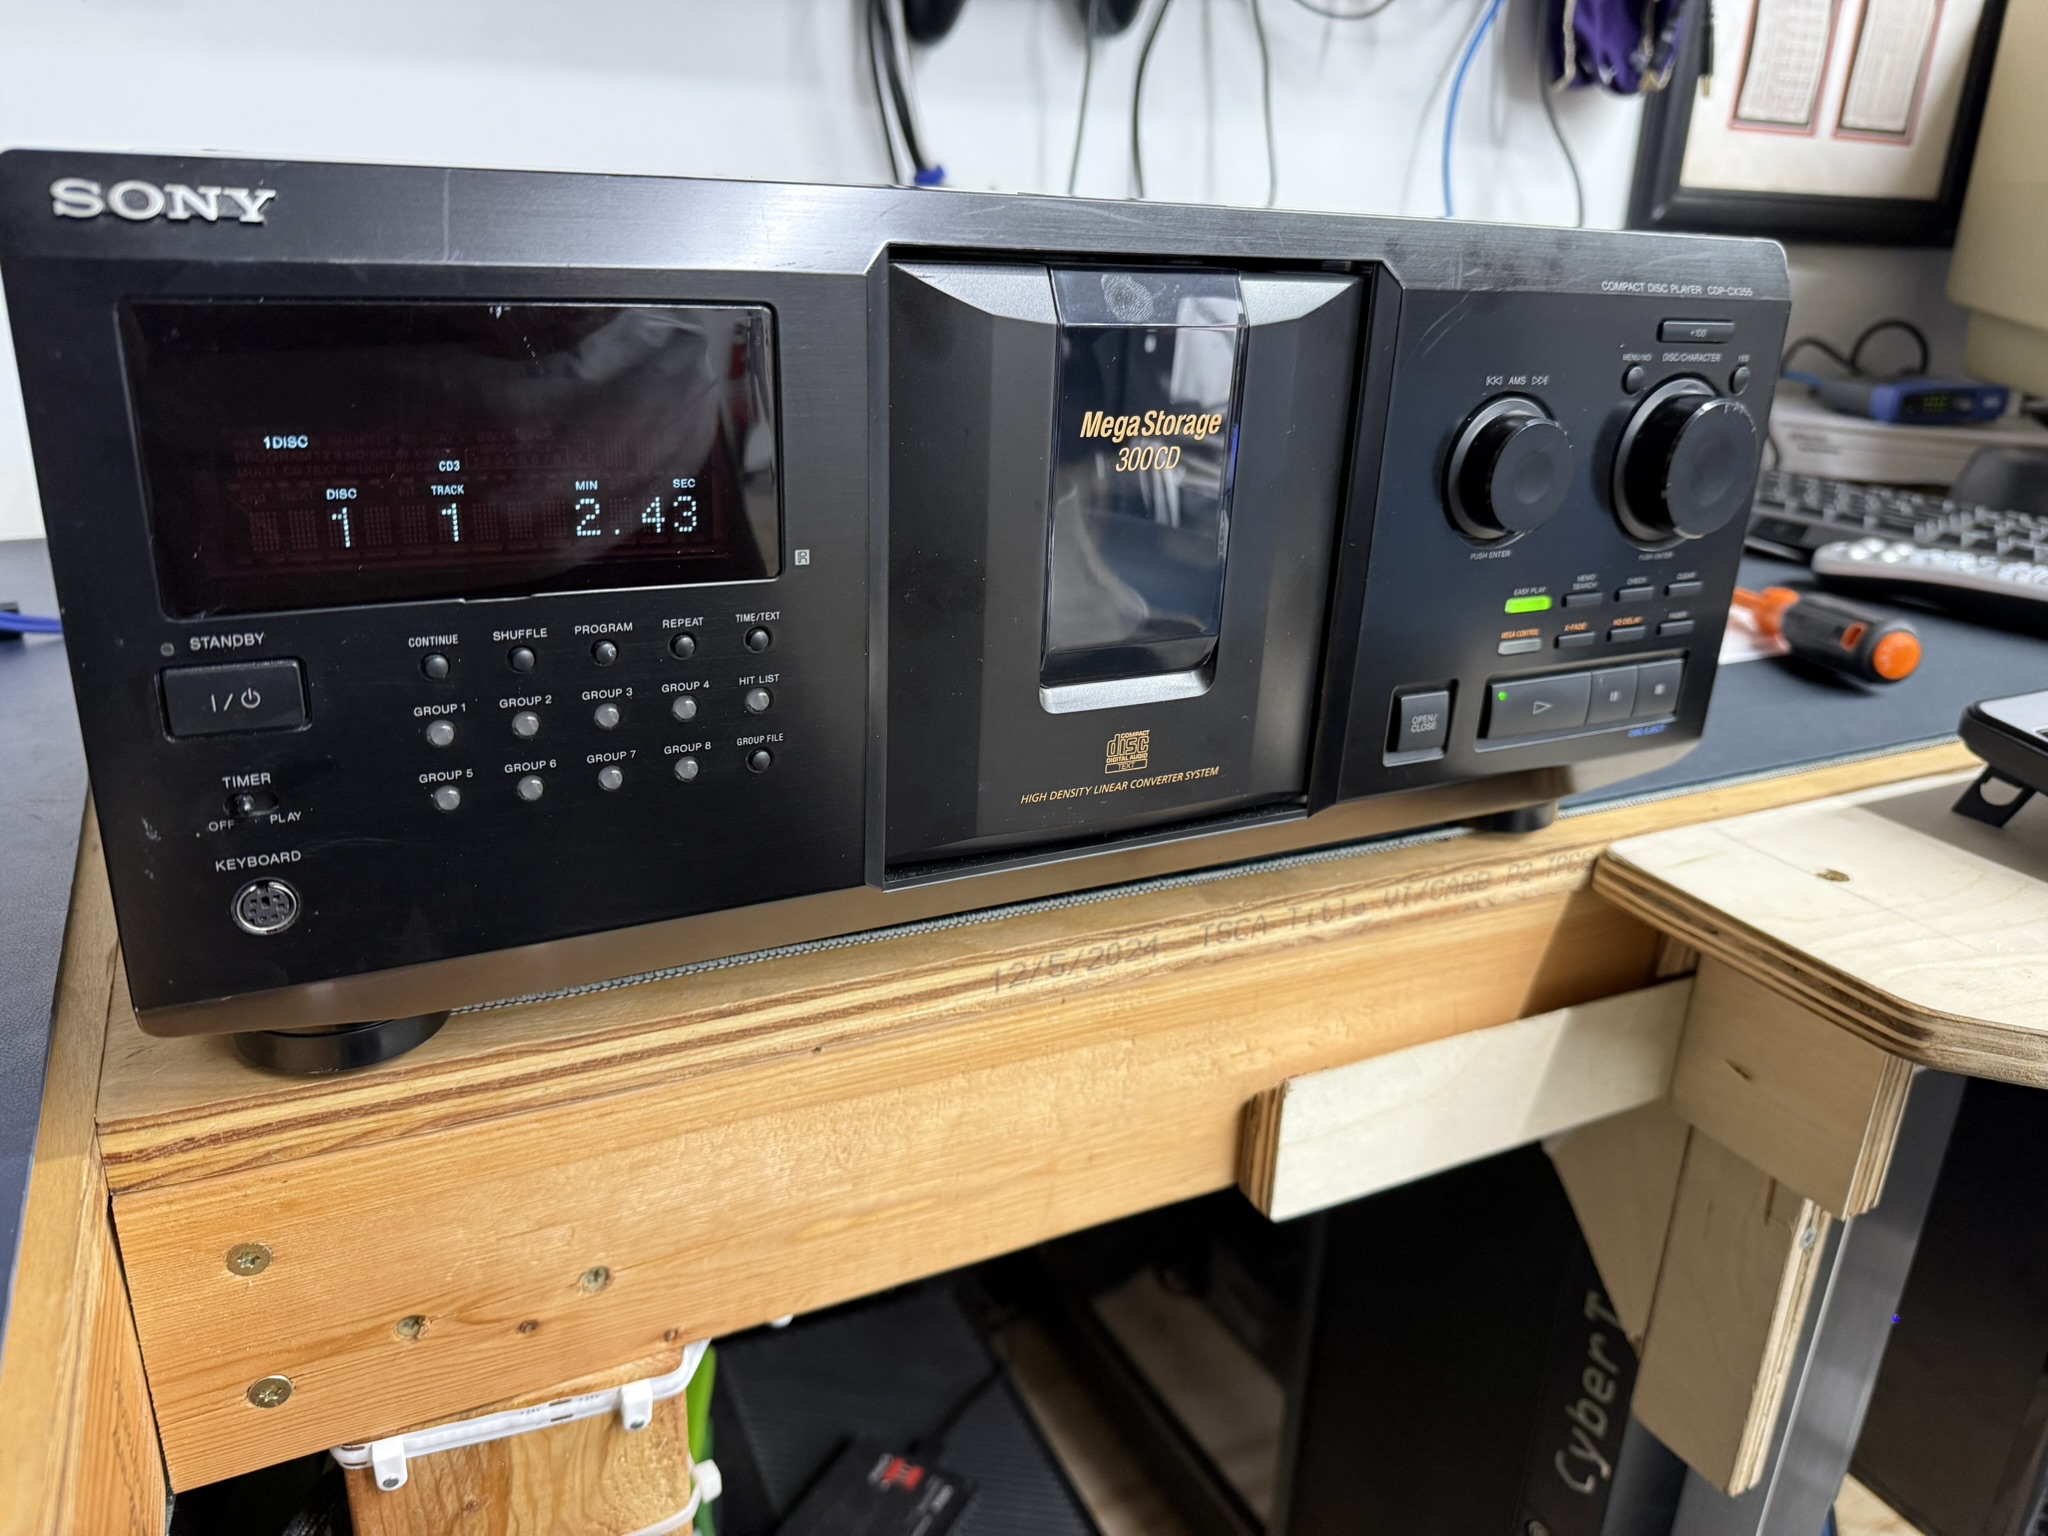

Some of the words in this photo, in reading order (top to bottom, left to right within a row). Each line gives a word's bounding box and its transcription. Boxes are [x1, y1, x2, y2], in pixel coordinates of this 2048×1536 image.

[50, 178, 276, 222] SONY
[1601, 280, 1646, 292] COMPACT
[1647, 283, 1669, 293] DISC
[1669, 284, 1703, 295] PLAYER
[1707, 285, 1753, 297] CDP-CX355
[1662, 353, 1722, 363] DISC/CHARACTER
[1508, 375, 1527, 385] AMS
[438, 459, 461, 472] CD3
[325, 487, 358, 501] DISC
[430, 483, 465, 497] TRACK
[574, 479, 599, 492] MIN
[672, 477, 696, 489] SEC
[331, 506, 352, 549] 1
[440, 502, 461, 544] 1
[1470, 551, 1487, 560] PUSH
[1488, 550, 1511, 559] ENTER
[1513, 587, 1529, 596] EASY
[1529, 586, 1546, 595] PLAY
[662, 616, 704, 629] REPEAT
[735, 611, 781, 624] TIME/TEXT
[492, 627, 549, 641] SHUFFLE
[574, 622, 633, 635] PROGRAM
[1500, 631, 1516, 640] MEGA
[1516, 628, 1540, 638] CONTROL
[189, 632, 265, 651] STANDBY
[408, 634, 459, 648] CONTINUE
[738, 676, 755, 686] HIT
[758, 673, 780, 684] LIST
[581, 689, 623, 701] GROUP
[626, 687, 633, 697] 3
[661, 682, 701, 694] GROUP
[702, 680, 710, 689] 4
[499, 696, 542, 709] GROUP
[544, 694, 552, 705] 2
[413, 704, 458, 717] GROUP
[461, 702, 467, 713] 1
[1411, 713, 1438, 724] OPEN/
[1120, 729, 1150, 739] COMPACT
[1410, 721, 1437, 733] CLOSE
[736, 735, 765, 747] GROUP
[766, 732, 784, 743] FILE
[1106, 733, 1150, 758] disc
[663, 742, 703, 756] GROUP
[704, 740, 712, 750] 8
[586, 752, 628, 765] GROUP
[629, 749, 637, 760] 7
[1105, 755, 1129, 764] DIGITAL
[1129, 752, 1149, 761] AUDIO
[504, 760, 547, 774] GROUP
[549, 759, 557, 769] 6
[1117, 761, 1136, 770] TEXT
[221, 772, 272, 789] TIMER
[418, 770, 463, 785] GROUP
[466, 768, 474, 779] 5
[1020, 791, 1048, 805] HIGH
[1049, 786, 1092, 801] DENSITY
[1093, 780, 1129, 795] LINEAR
[1130, 772, 1184, 790] CONVERTER
[1185, 766, 1220, 781] SYSTEM
[269, 810, 302, 825] PLAY
[208, 819, 235, 832] OFF
[214, 850, 302, 873] KEYBOARD
[991, 936, 1160, 993] 12/5/2024
[1199, 916, 1267, 947] TSCA
[1287, 898, 1367, 929] Title
